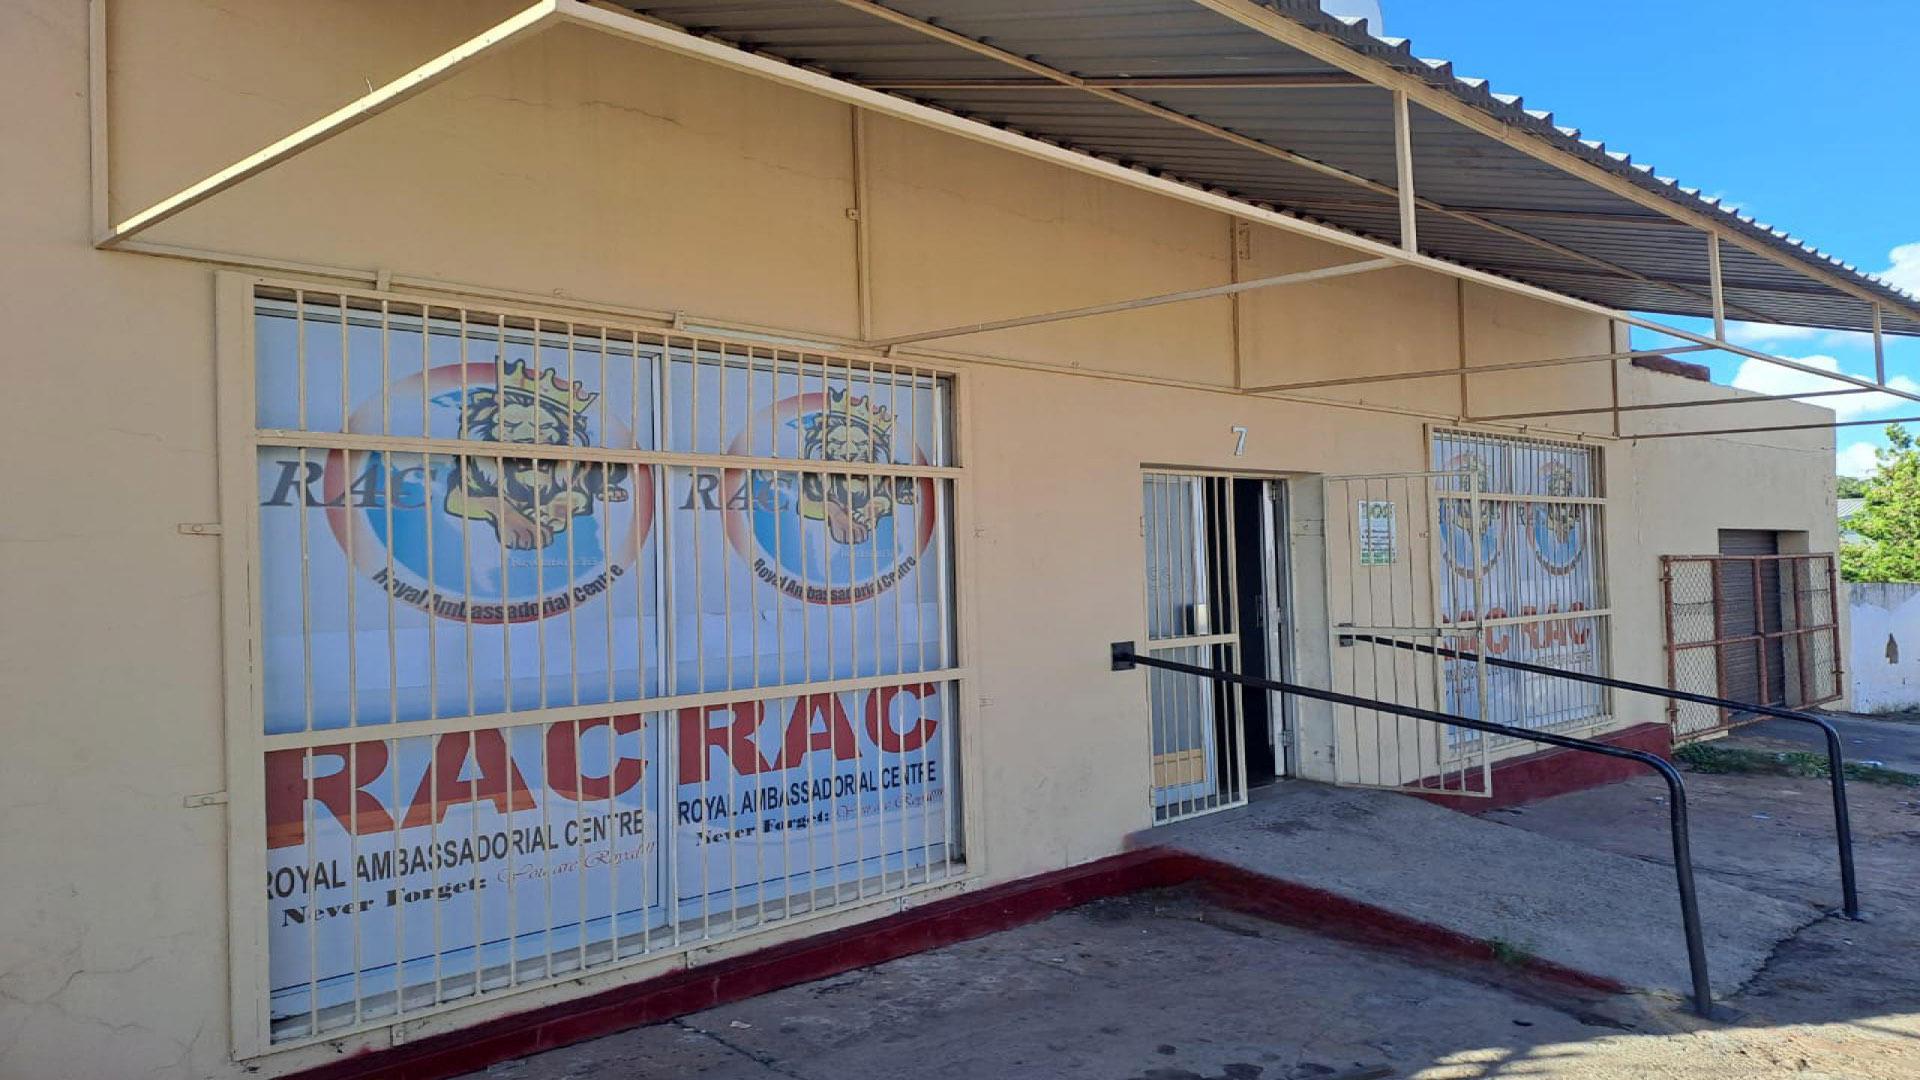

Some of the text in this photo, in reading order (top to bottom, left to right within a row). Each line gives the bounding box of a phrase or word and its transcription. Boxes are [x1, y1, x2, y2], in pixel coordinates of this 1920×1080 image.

[1231, 425, 1248, 456] 7
[260, 459, 437, 508] RAC
[678, 473, 794, 511] RAC
[1442, 607, 1510, 660] AC
[680, 682, 938, 785] RAC
[265, 713, 649, 850] RAC
[356, 823, 559, 883] AMBASSADORIAL
[281, 899, 375, 927] Never
